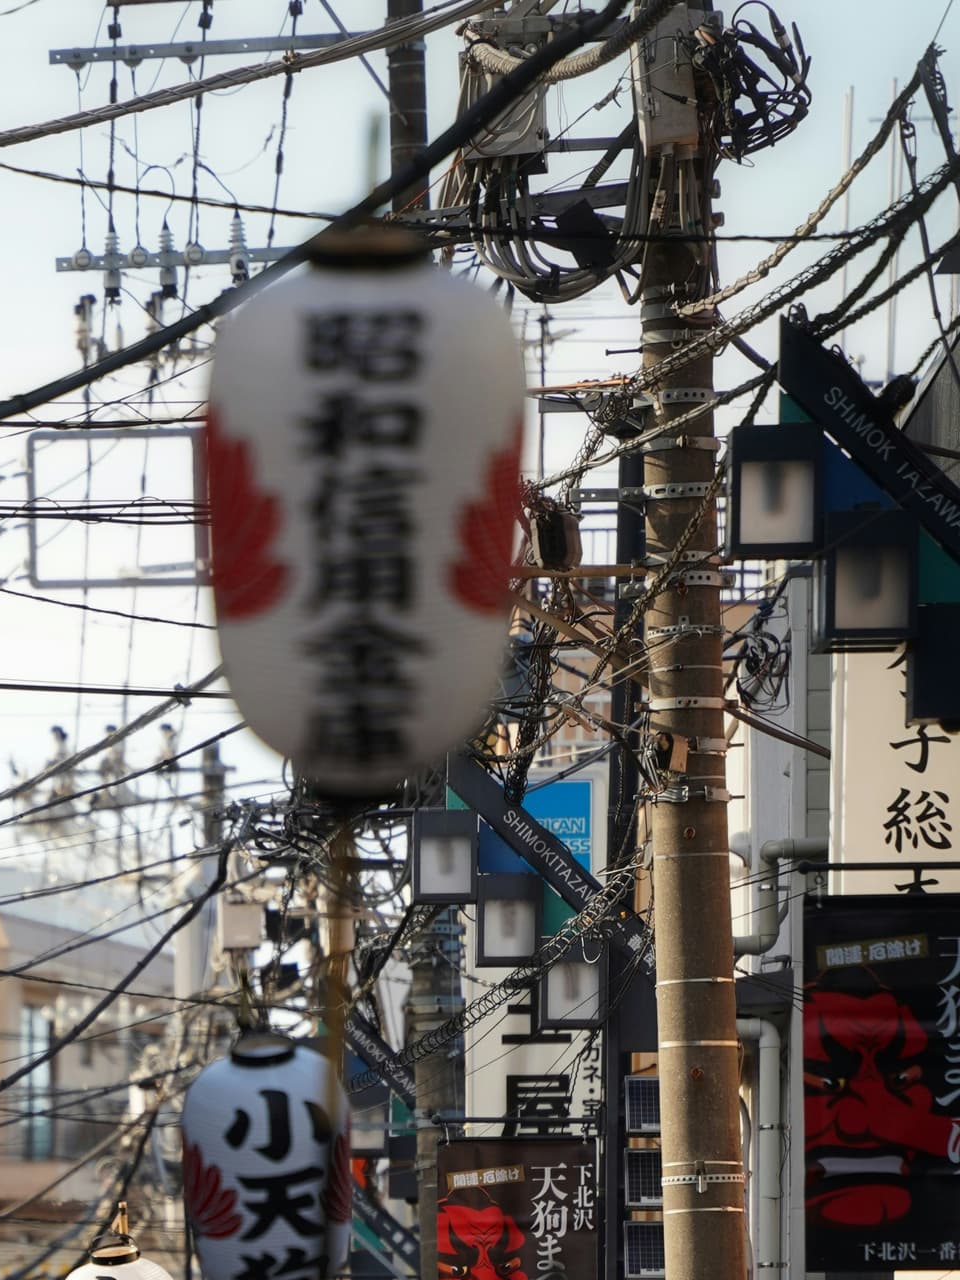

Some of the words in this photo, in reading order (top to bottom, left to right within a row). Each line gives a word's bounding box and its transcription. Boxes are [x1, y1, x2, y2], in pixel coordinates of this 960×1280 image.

[572, 1163, 596, 1231] 下北沢
[862, 1241, 960, 1262] 下北沢一番
